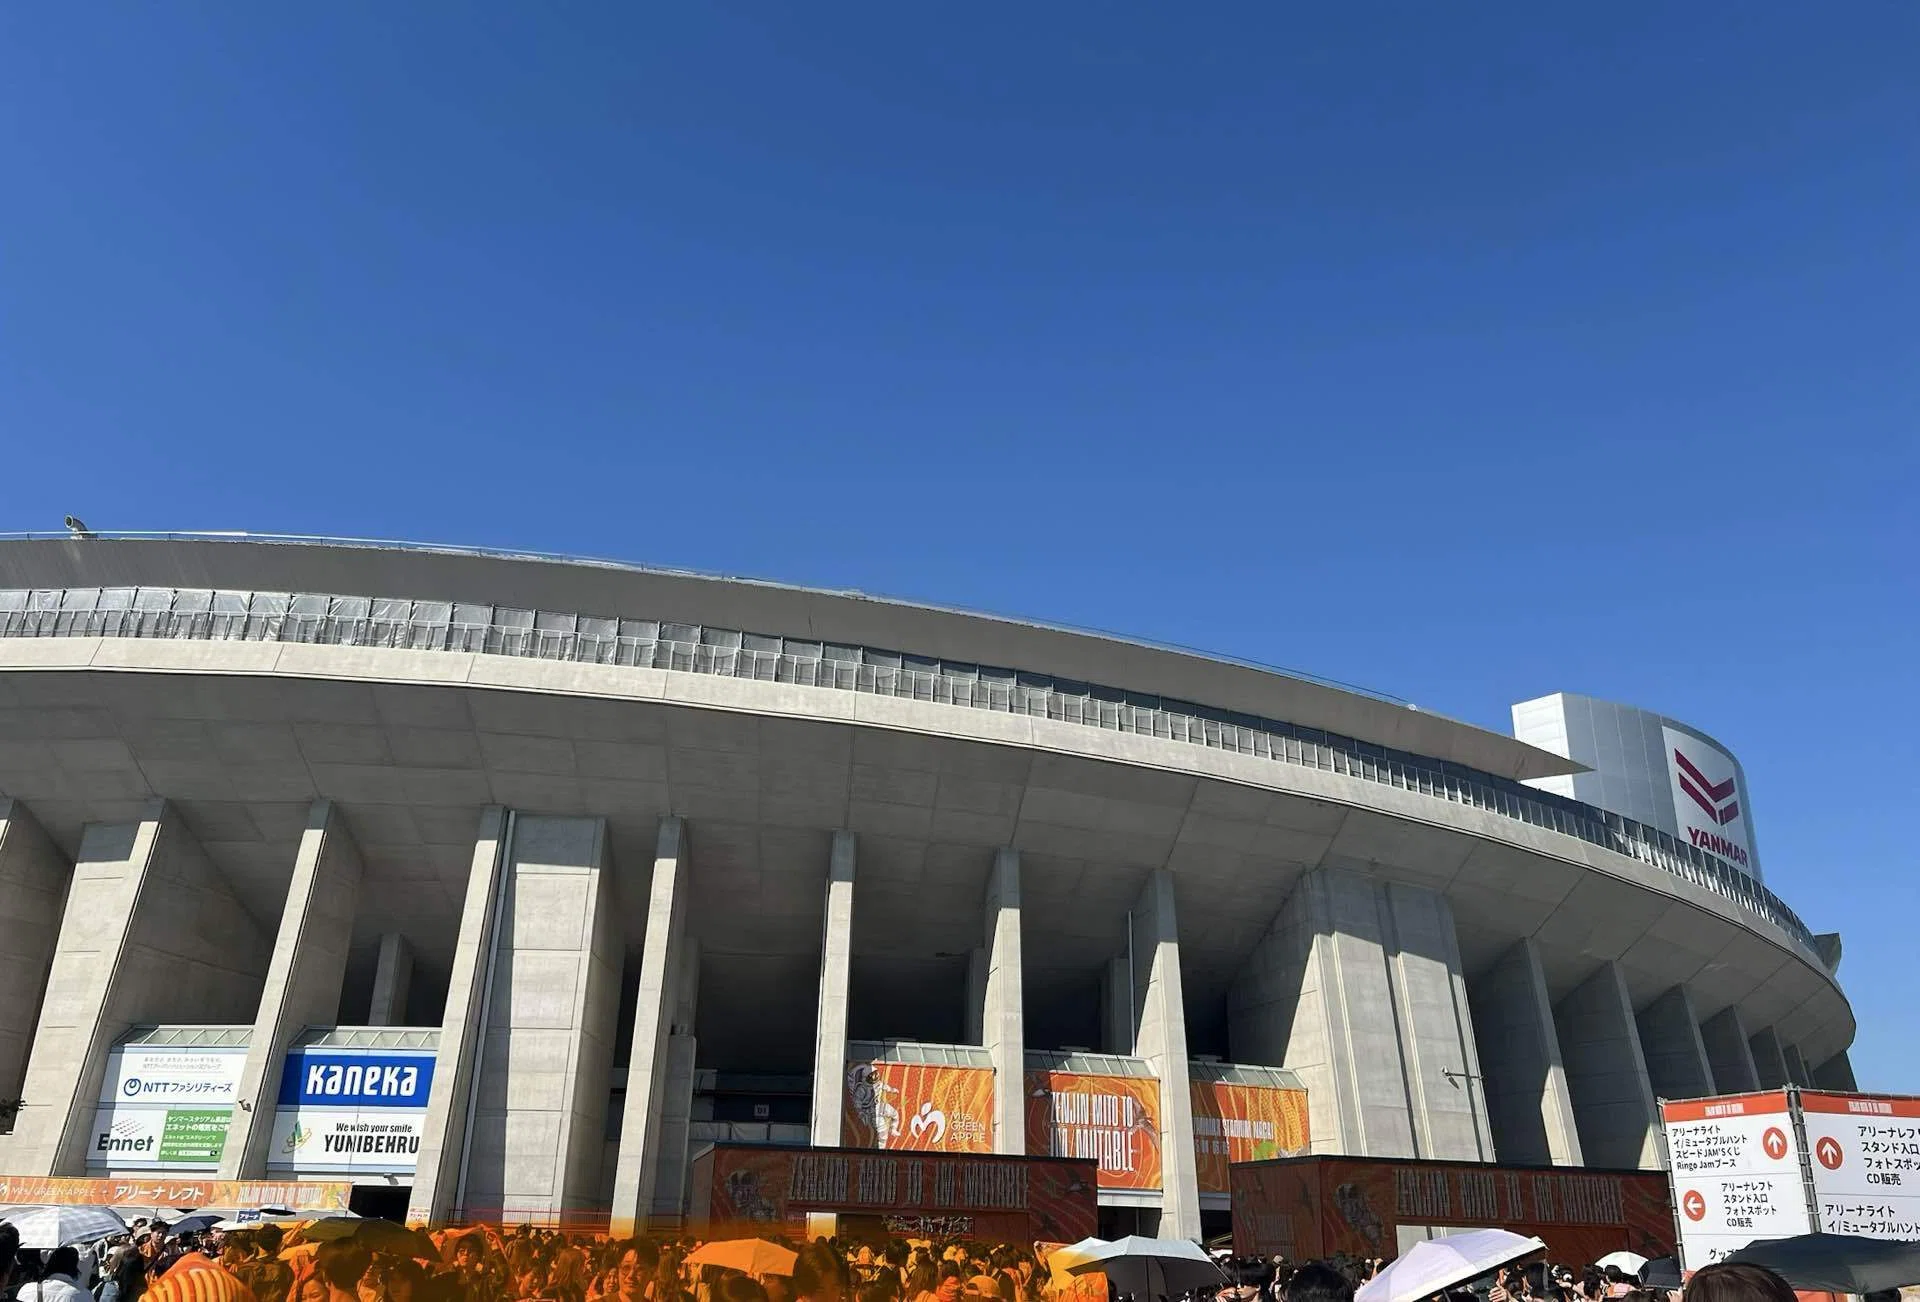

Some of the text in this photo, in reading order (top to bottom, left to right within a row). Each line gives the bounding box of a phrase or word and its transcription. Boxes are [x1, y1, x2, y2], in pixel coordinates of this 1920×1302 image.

[1687, 827, 1749, 868] YANMAR
[143, 1082, 233, 1093] NTTファシリティーズ
[1092, 1094, 1119, 1127] MITO
[1121, 1096, 1134, 1128] TO
[336, 1123, 413, 1134] We wish your smile
[951, 1121, 986, 1132] GREEN
[1672, 1125, 1721, 1137] アリーナライト
[1858, 1125, 1920, 1139] アリーナレフ
[97, 1133, 154, 1151] Ennet
[951, 1132, 986, 1143] APPLE
[1674, 1134, 1748, 1149] イ/ミュータブルハント
[324, 1134, 420, 1154] YUNIBEHRU
[1861, 1141, 1920, 1155] スタンド入口
[1677, 1159, 1737, 1171] Ringo Jamブース
[1867, 1173, 1902, 1186] CD販売
[34, 1186, 63, 1197] GREEN
[67, 1186, 96, 1197] APPLE
[1721, 1181, 1773, 1192] アリーナレフト
[113, 1186, 204, 1201] アリーナ レフト
[1723, 1193, 1768, 1204] スタンド入口
[1725, 1205, 1777, 1216] フォトスポット
[1825, 1204, 1895, 1218] アリーナライト
[1727, 1217, 1753, 1228] CD販売
[1828, 1221, 1920, 1235] イ/ミュータブルハント
